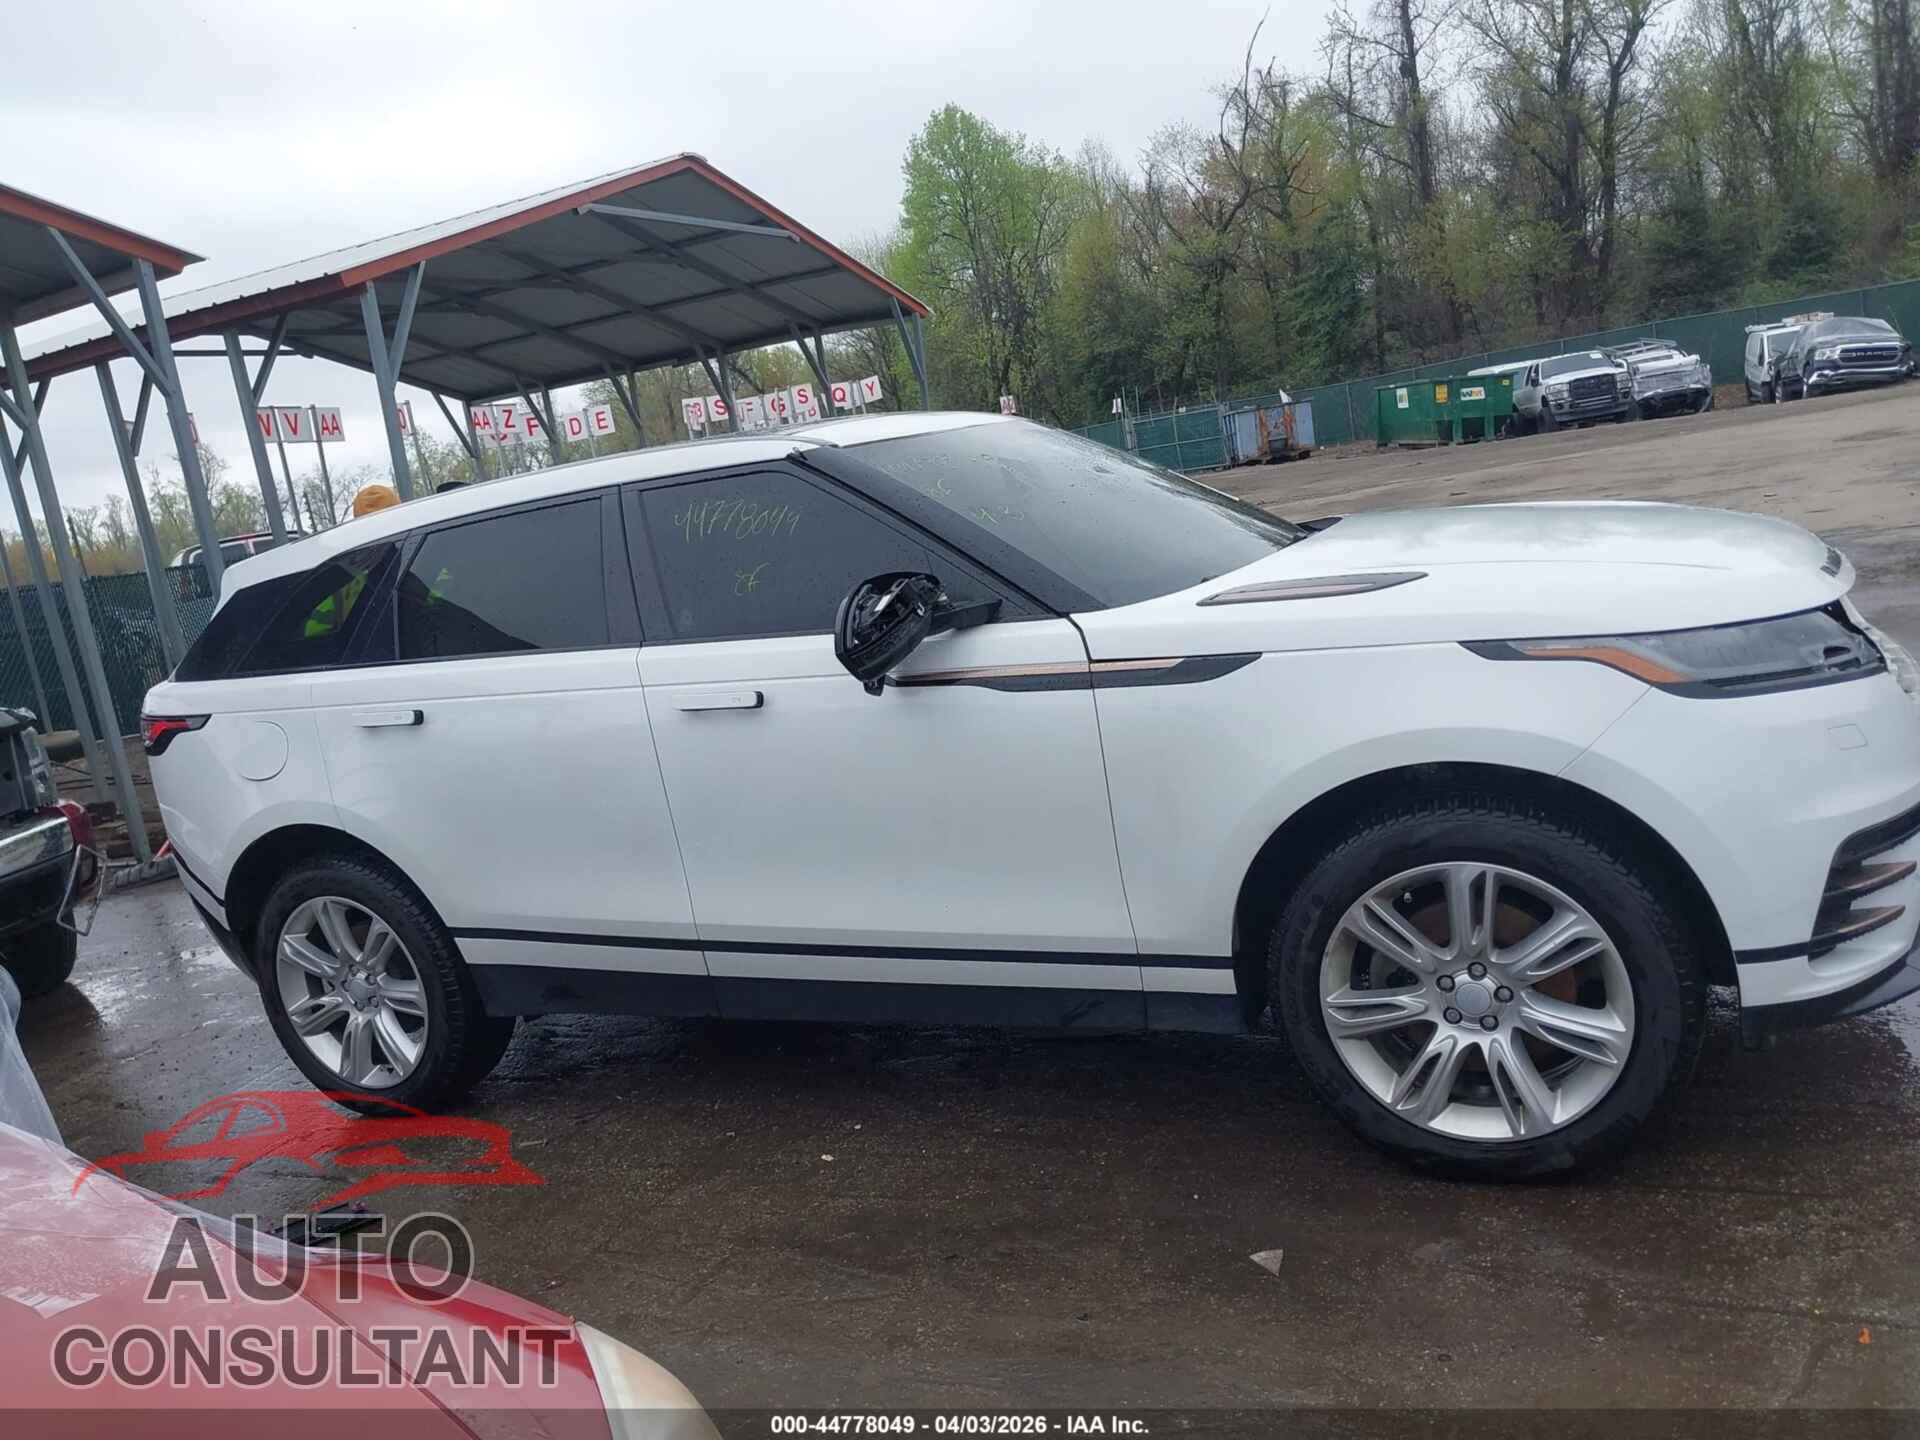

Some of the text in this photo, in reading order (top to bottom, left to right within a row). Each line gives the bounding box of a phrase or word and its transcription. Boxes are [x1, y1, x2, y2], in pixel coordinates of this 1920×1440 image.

[797, 388, 809, 404] S
[832, 387, 847, 402] Q
[865, 380, 875, 397] Y
[714, 399, 729, 416] S
[283, 412, 298, 436] V
[320, 413, 342, 436] AA
[473, 410, 492, 430] AA
[502, 408, 516, 429] Z
[569, 417, 582, 436] D
[595, 410, 609, 430] E
